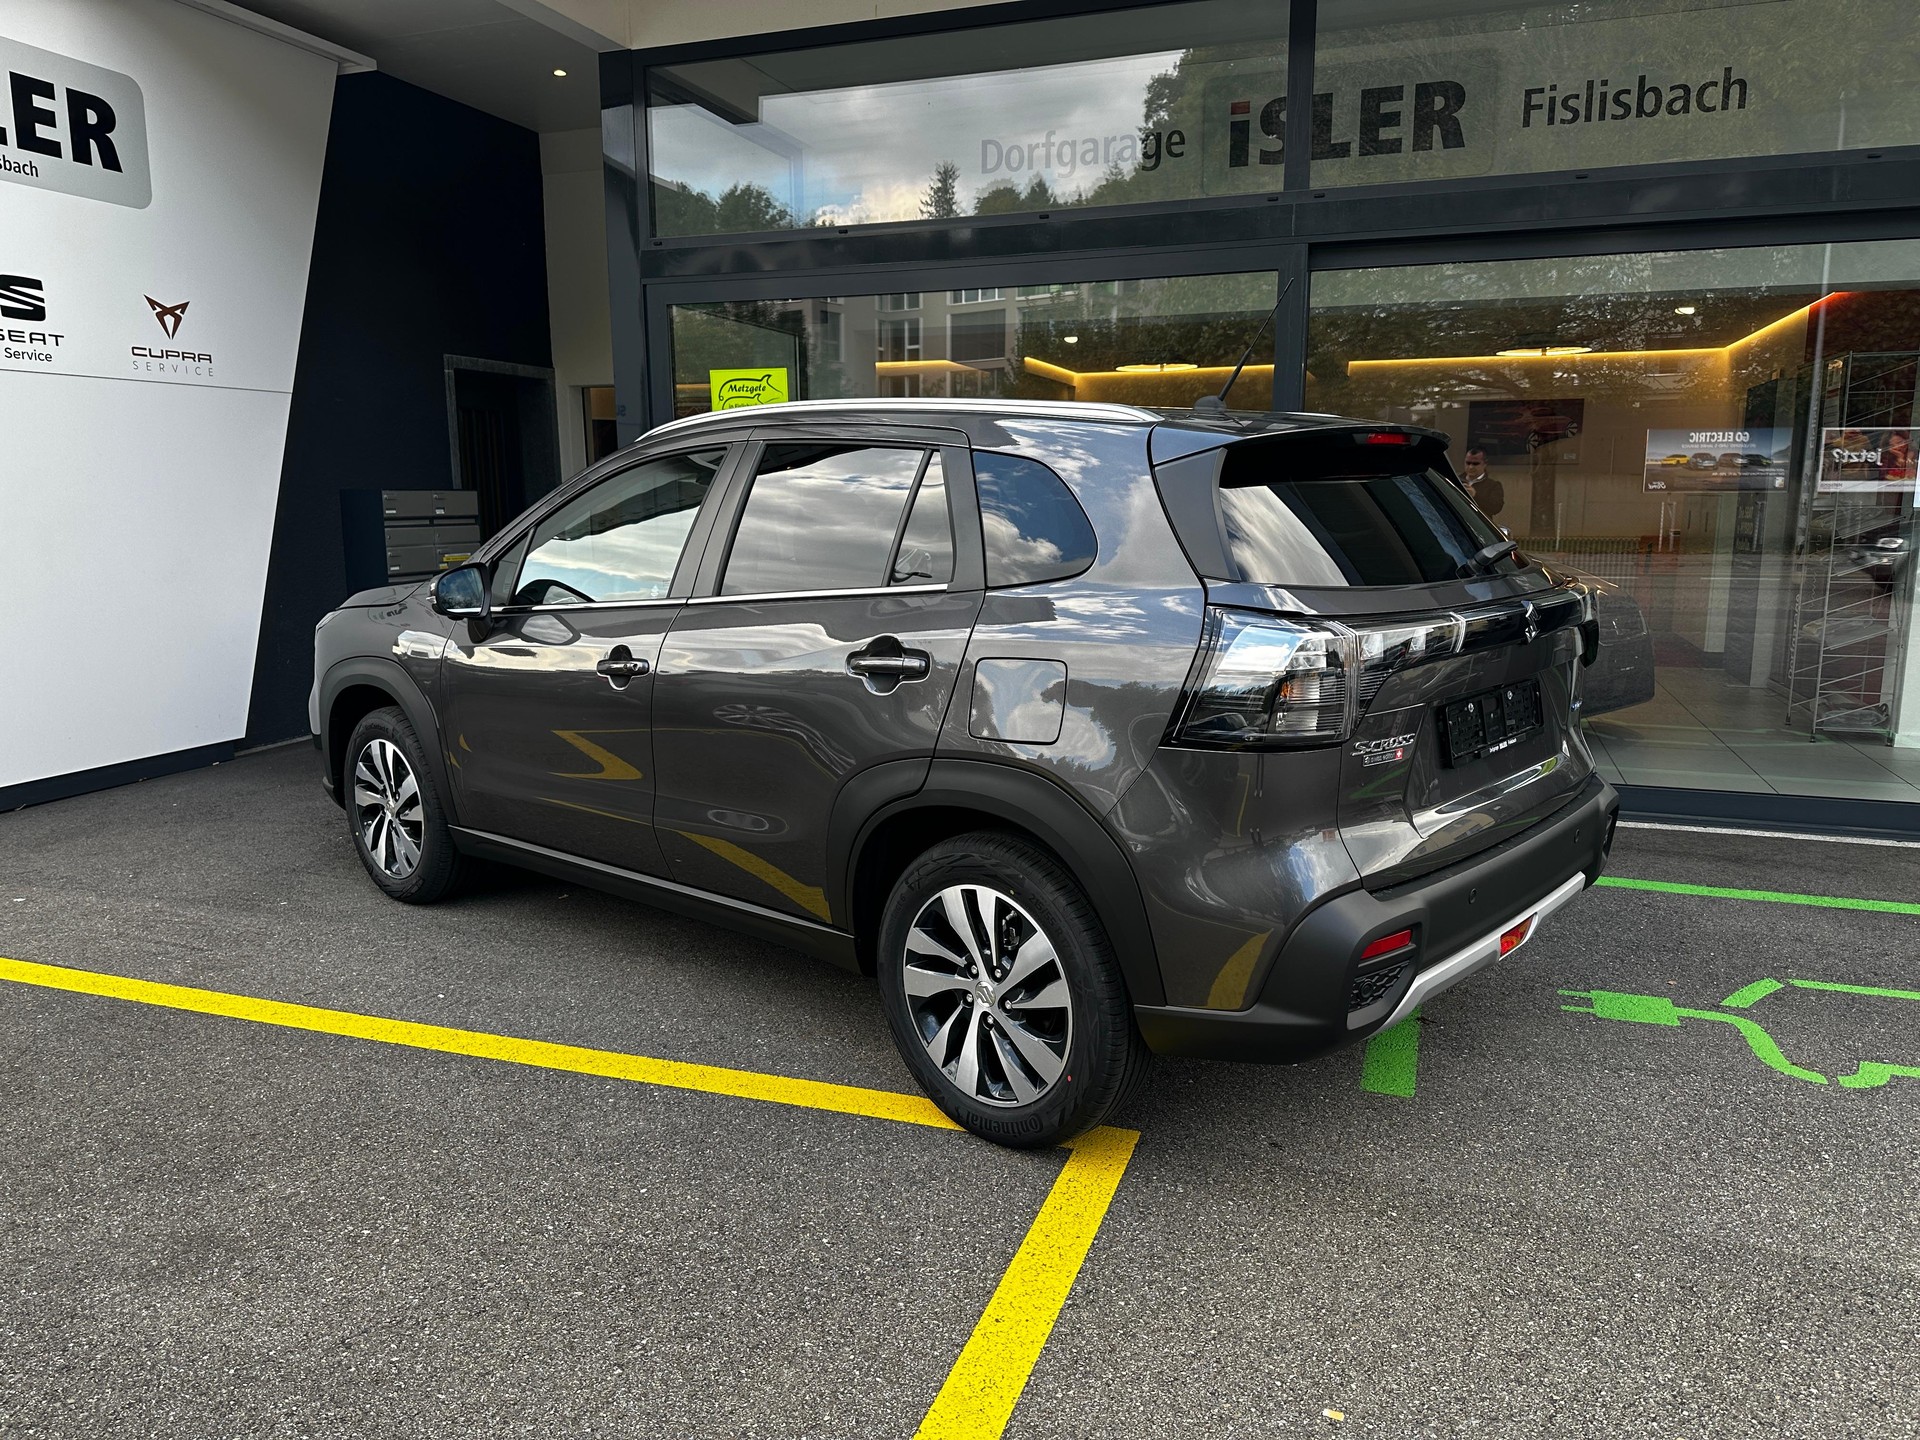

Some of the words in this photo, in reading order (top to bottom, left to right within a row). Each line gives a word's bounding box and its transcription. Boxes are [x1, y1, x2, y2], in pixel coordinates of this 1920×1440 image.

[0, 70, 124, 174] ER
[981, 128, 1186, 179] Dorfgarage
[1522, 66, 1748, 128] Fislisbach
[4, 346, 53, 363] Service
[131, 346, 213, 364] CUPRA
[132, 360, 215, 377] SERVICE
[727, 383, 767, 395] Metzgete
[965, 1110, 1044, 1137] Continental
